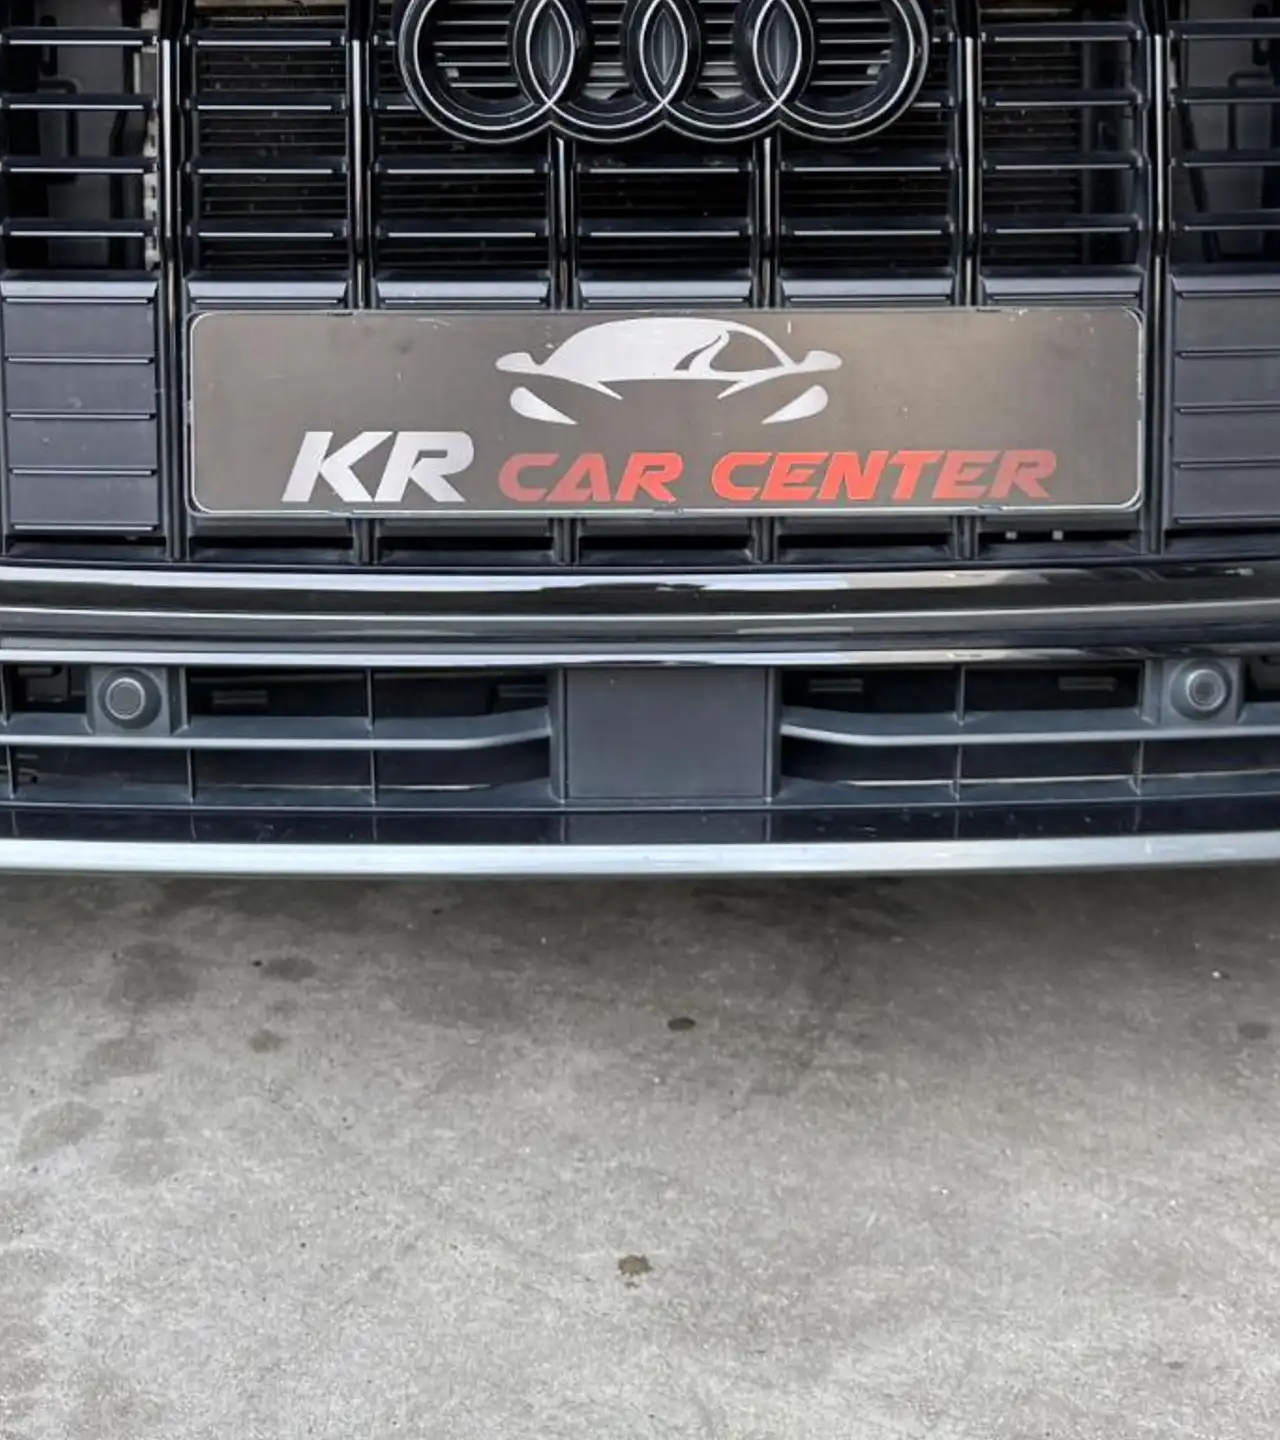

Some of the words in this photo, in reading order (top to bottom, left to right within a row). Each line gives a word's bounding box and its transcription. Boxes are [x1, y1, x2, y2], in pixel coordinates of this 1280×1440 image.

[281, 431, 475, 502] KR
[498, 452, 683, 503] CAR
[711, 449, 1057, 501] CENTER
